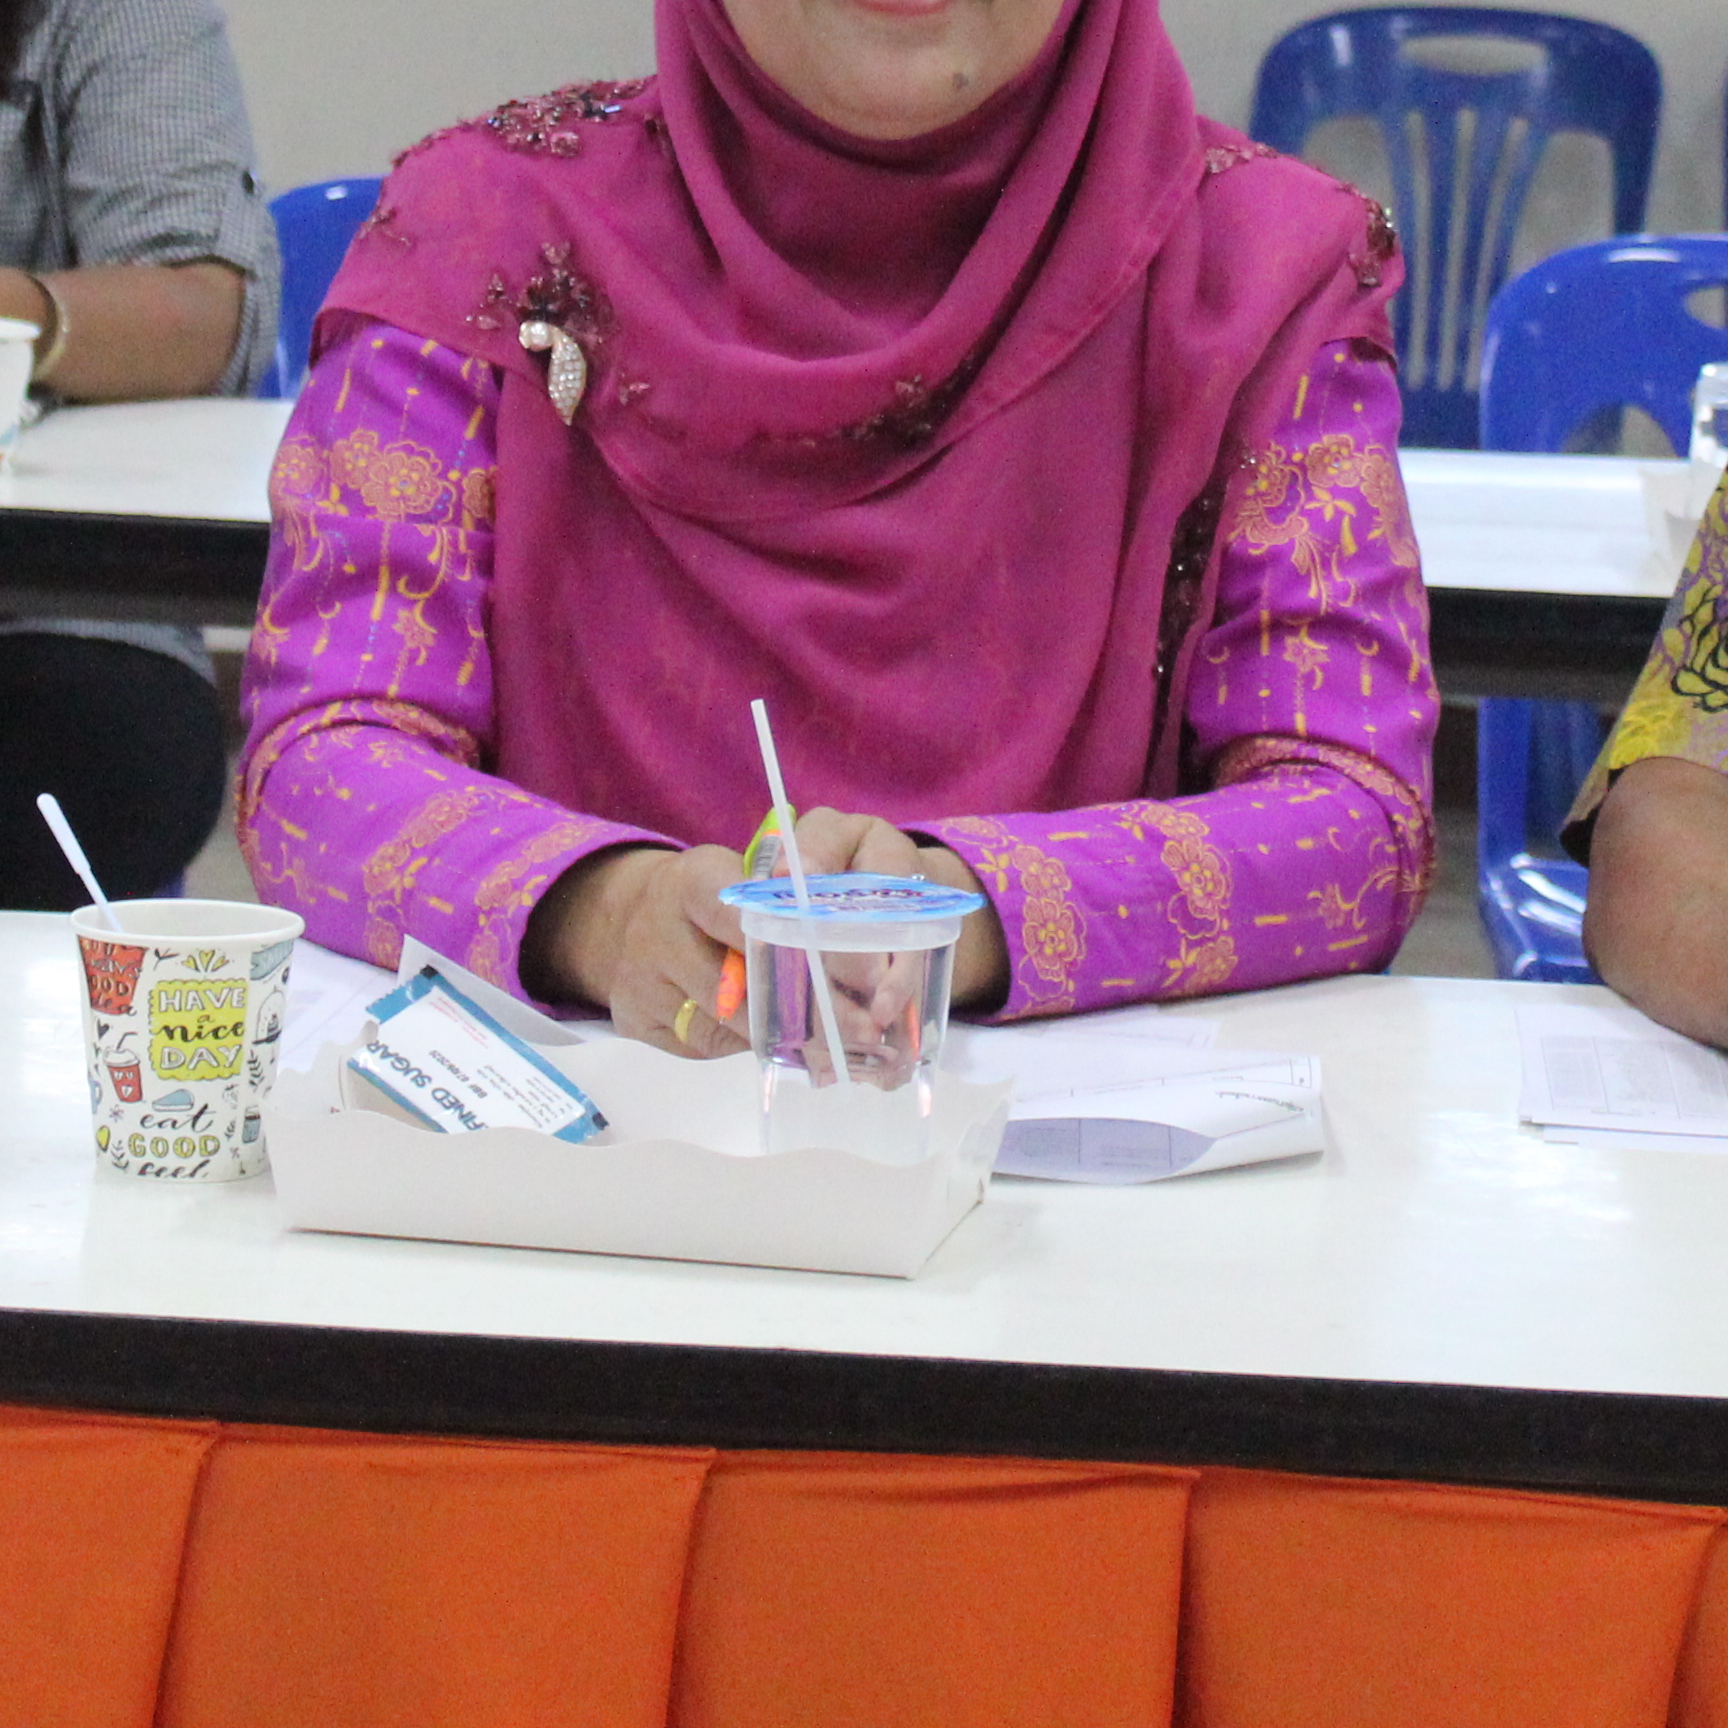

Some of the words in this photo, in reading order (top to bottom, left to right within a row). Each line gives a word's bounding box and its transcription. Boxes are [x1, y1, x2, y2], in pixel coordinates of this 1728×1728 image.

[158, 987, 246, 1013] HAVE
[156, 1021, 245, 1043] nice
[196, 1014, 215, 1024] a
[159, 1043, 242, 1071] DAY
[366, 1039, 432, 1089] SUGAR
[139, 1103, 216, 1133] eat
[430, 1086, 490, 1132] FINED
[127, 1132, 221, 1159] GOOD
